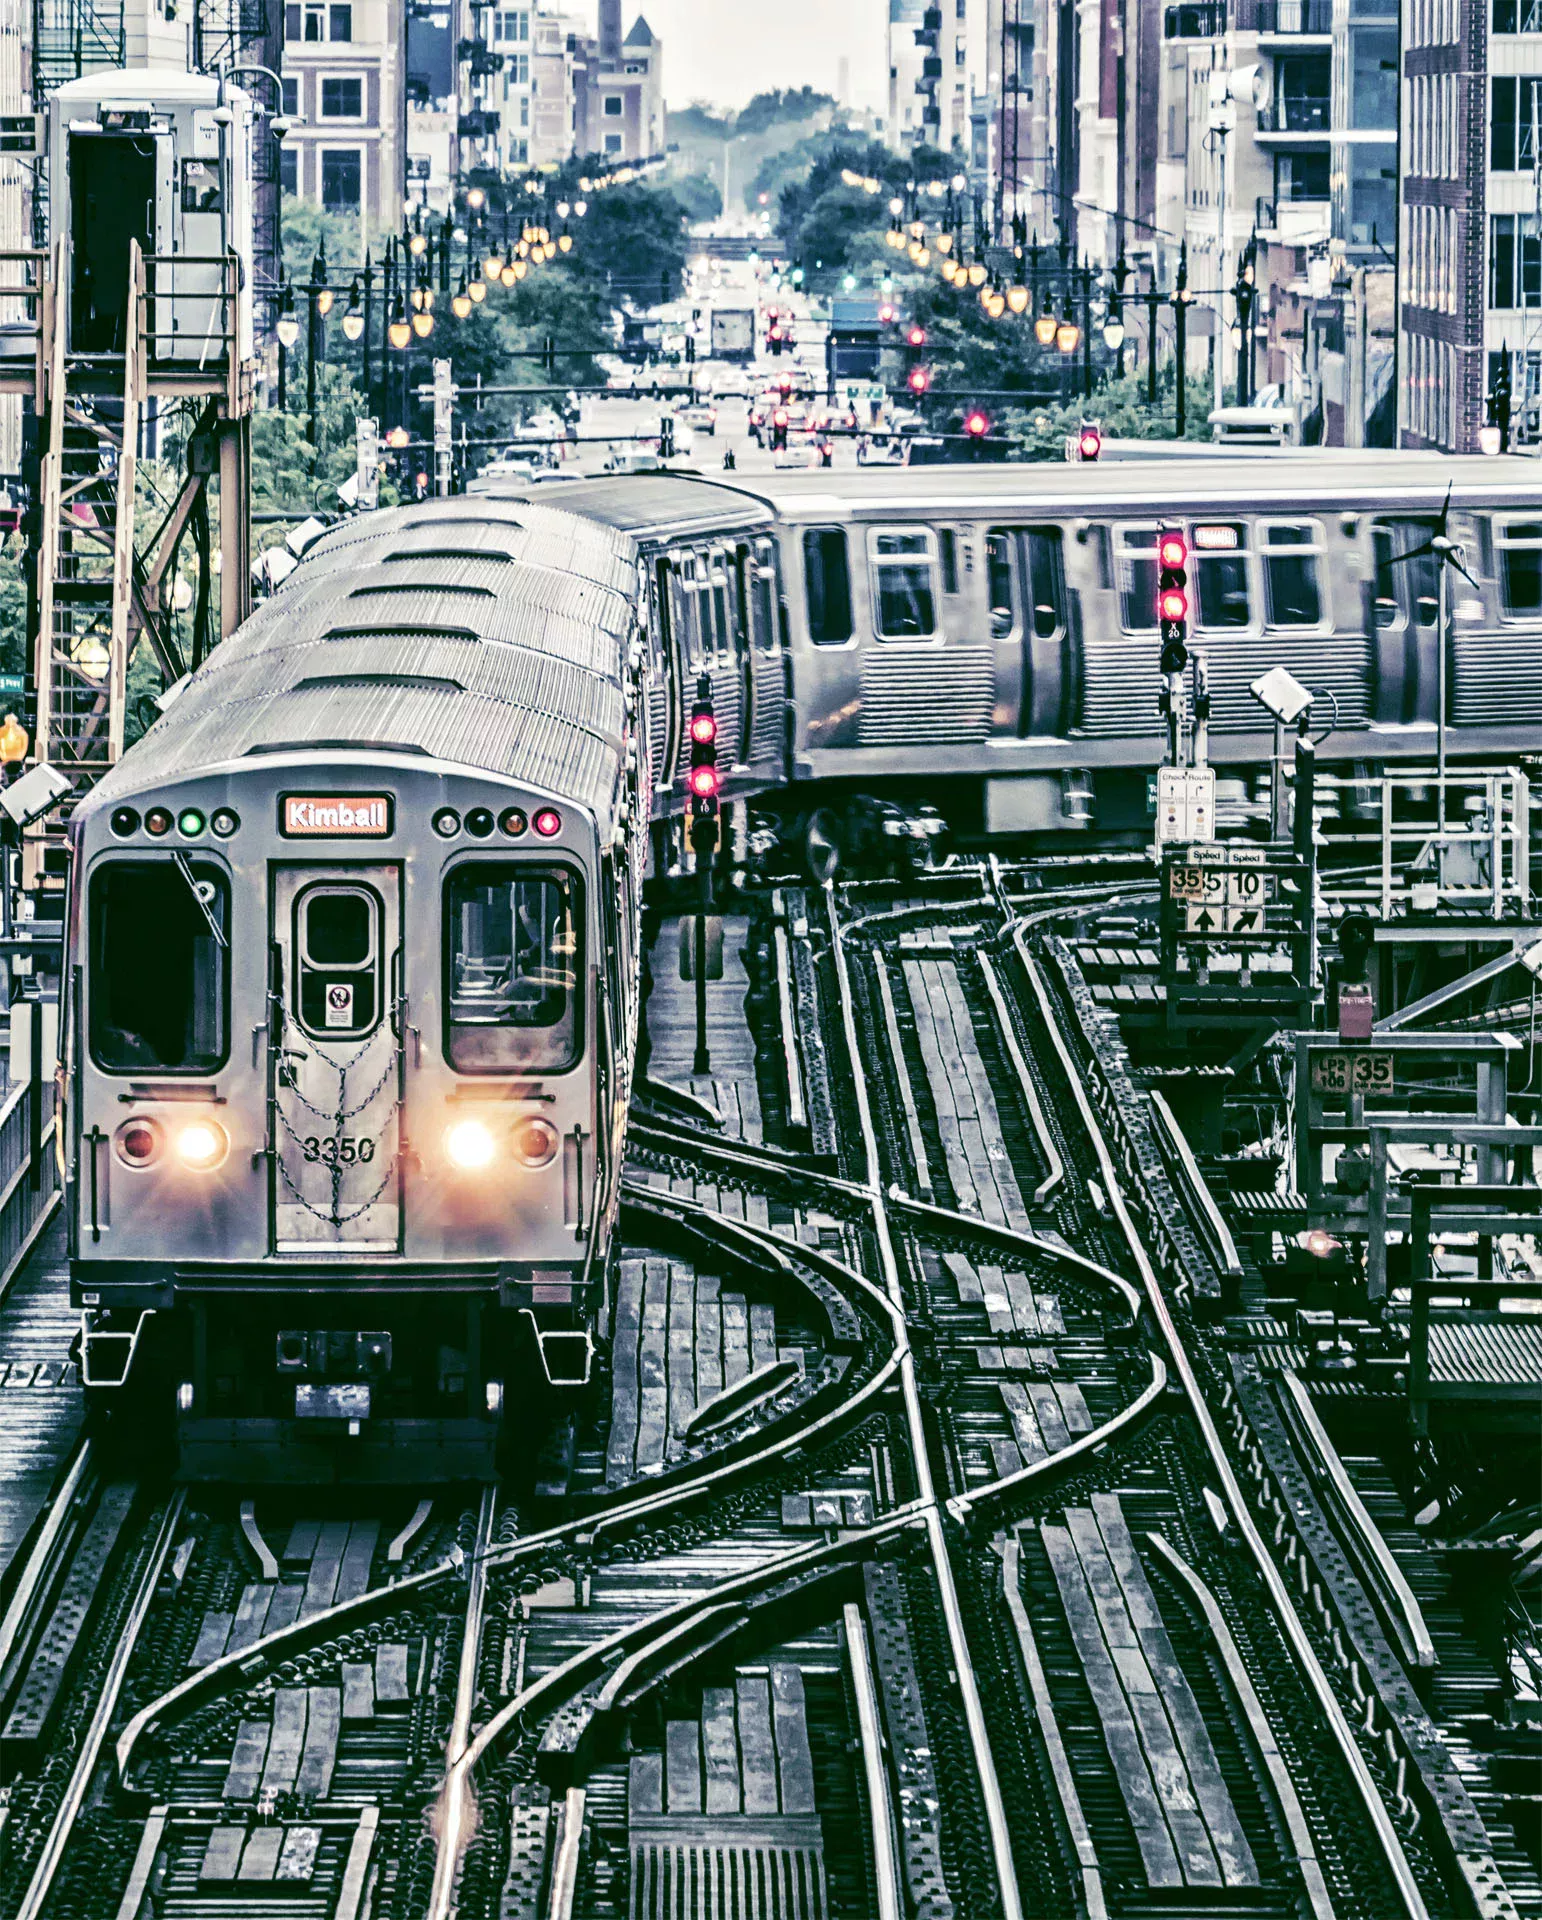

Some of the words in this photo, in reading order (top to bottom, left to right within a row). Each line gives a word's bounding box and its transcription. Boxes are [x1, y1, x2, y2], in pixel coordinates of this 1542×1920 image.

[1168, 629, 1180, 638] 20
[290, 803, 384, 827] Kimball
[1193, 851, 1220, 861] Speed
[1233, 854, 1260, 863] Speed
[1173, 869, 1200, 888] 35
[1202, 871, 1221, 891] 5
[1233, 872, 1260, 894] 10
[1239, 894, 1254, 902] mph
[1319, 1059, 1346, 1071] LP2
[1356, 1057, 1389, 1081] 35
[1320, 1075, 1345, 1088] 106
[1354, 1081, 1369, 1089] Cab
[303, 1136, 376, 1163] 3350
